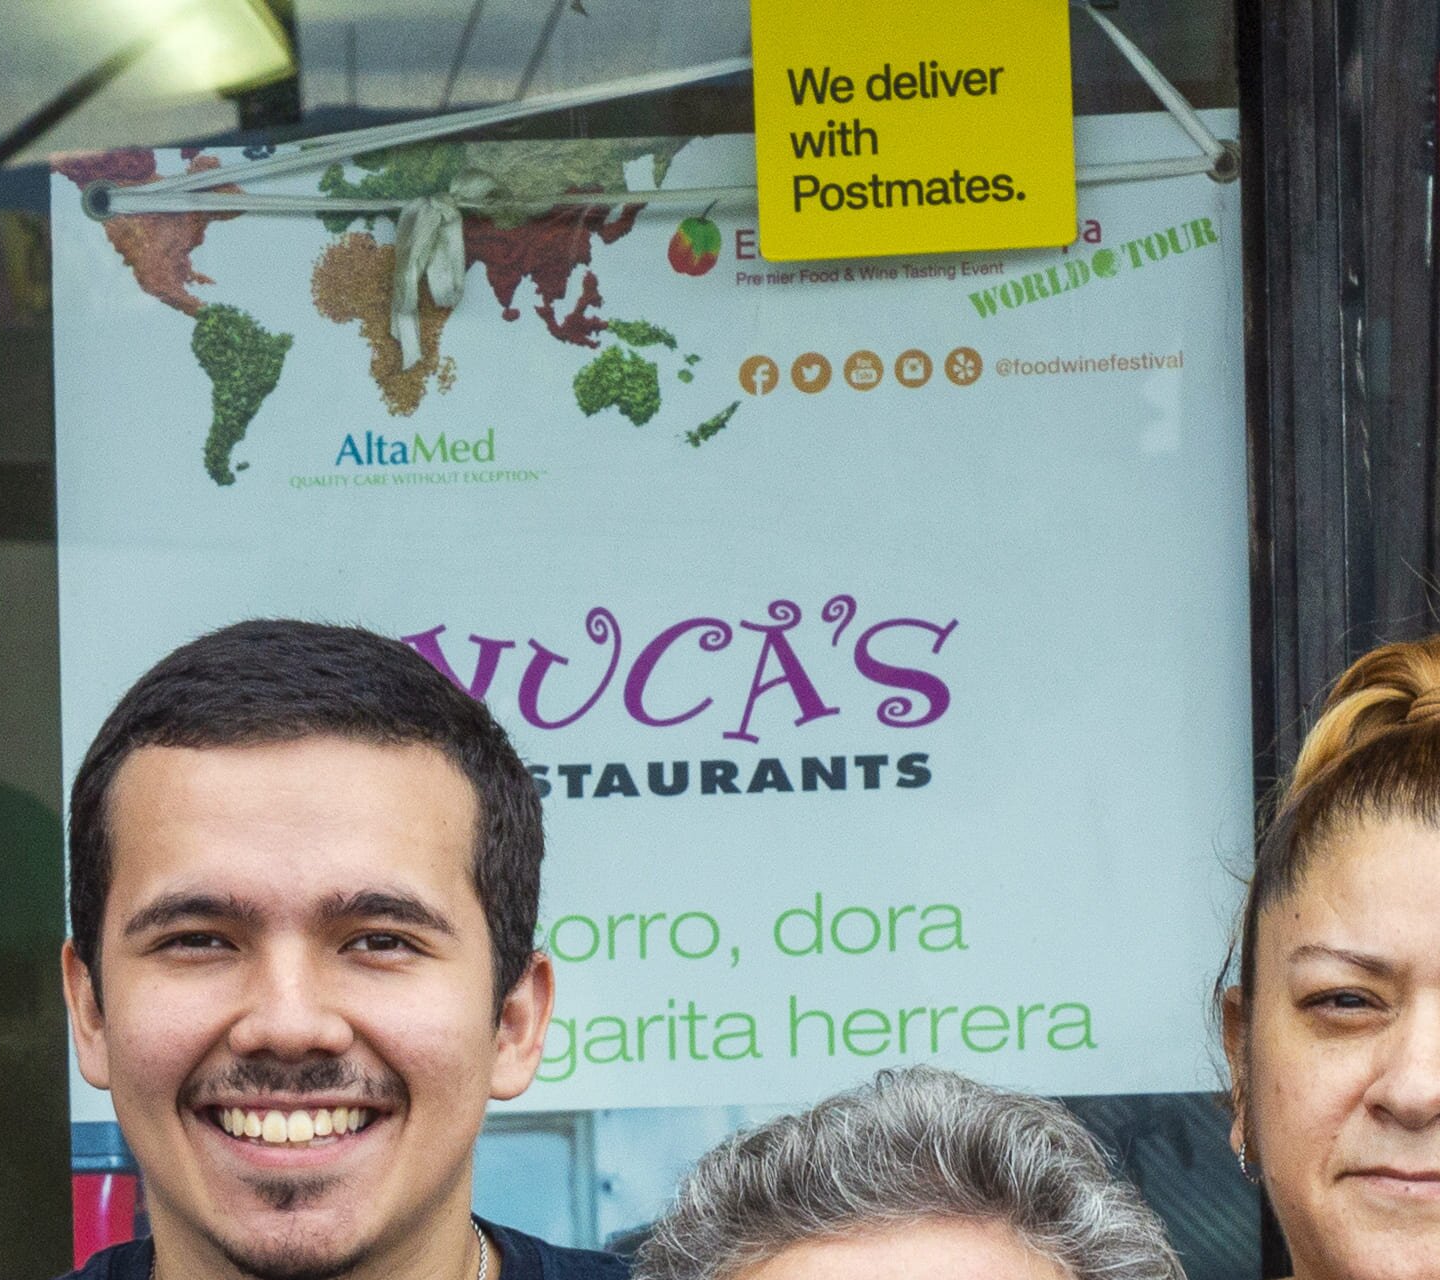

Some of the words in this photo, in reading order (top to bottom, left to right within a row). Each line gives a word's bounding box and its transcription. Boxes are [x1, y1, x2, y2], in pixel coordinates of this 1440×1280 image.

[787, 66, 855, 106] We
[866, 61, 1004, 102] deliver
[790, 119, 878, 159] with
[793, 169, 1026, 213] Postmates.
[800, 265, 840, 283] Food
[844, 268, 854, 282] &
[859, 265, 898, 280] Wine
[903, 263, 957, 280] Tasting
[962, 261, 1004, 276] Event
[968, 260, 1092, 319] WORLD
[1121, 217, 1218, 271] TOUR
[995, 351, 1184, 378] @foodwinefestival
[335, 427, 495, 466] AltaMed
[289, 476, 349, 490] QUALITY
[353, 475, 386, 486] CARE
[393, 471, 459, 485] WITHOUT
[529, 753, 933, 799] STAURANTS
[536, 904, 742, 968] orro,
[773, 892, 968, 957] dora
[535, 1005, 762, 1082] garita
[787, 995, 1097, 1058] herrera
